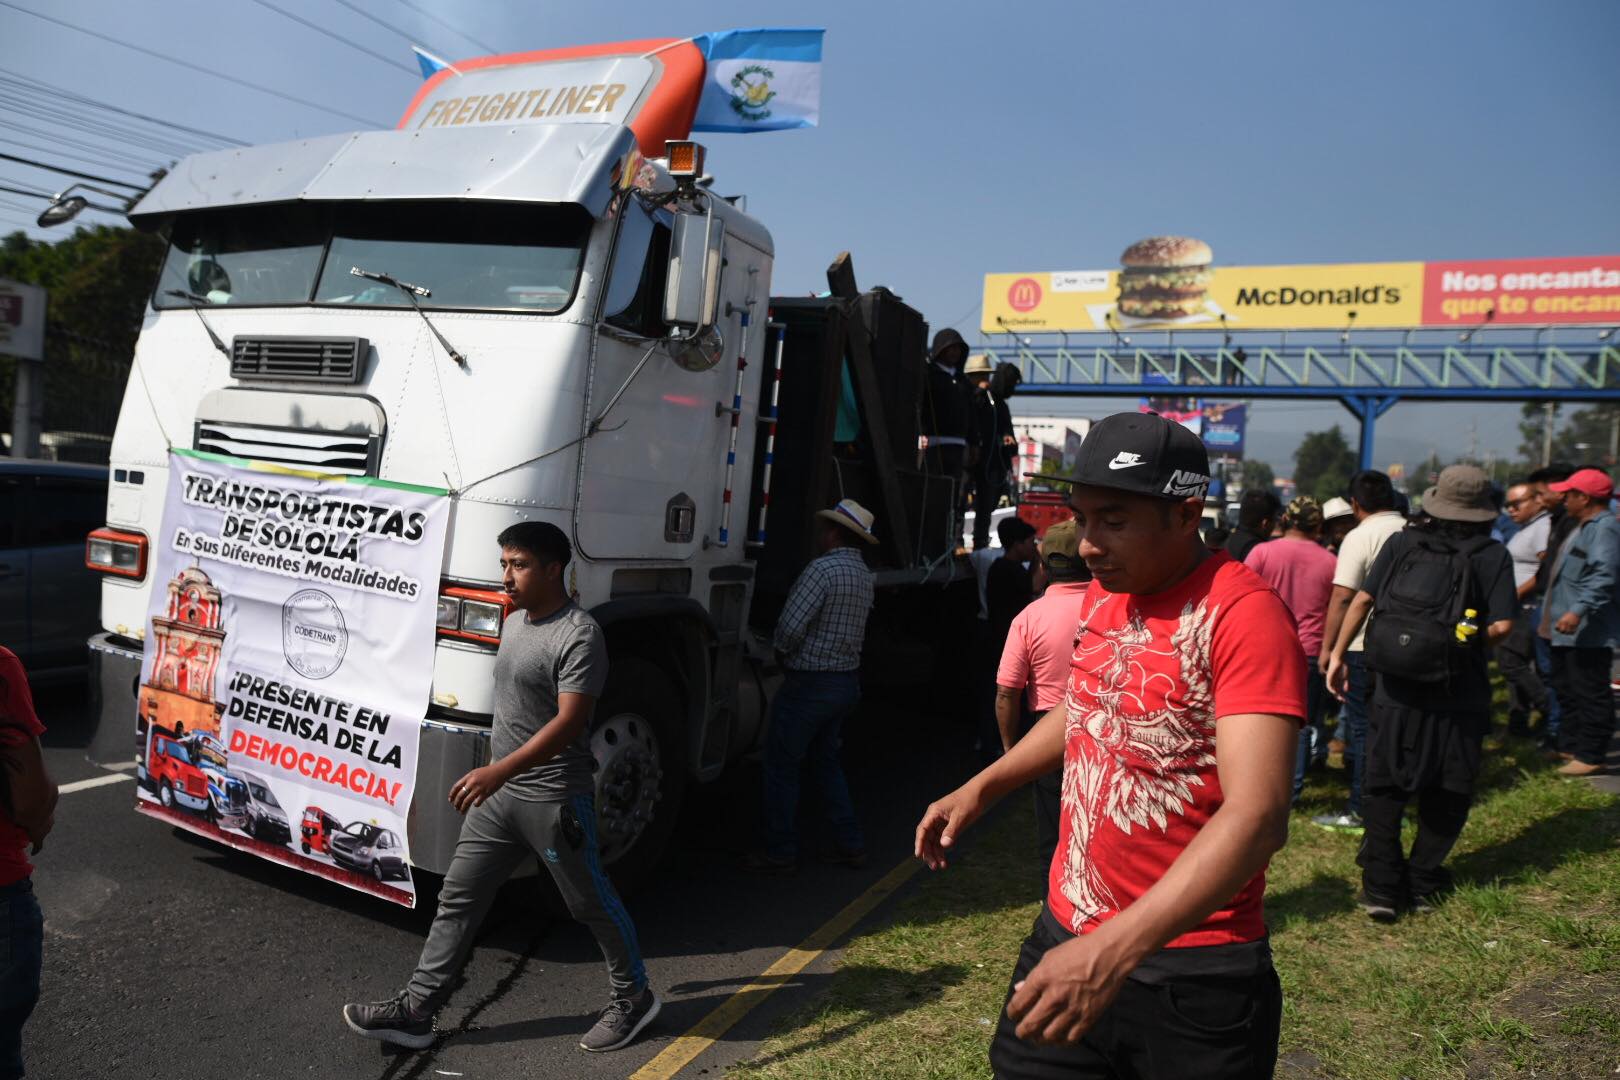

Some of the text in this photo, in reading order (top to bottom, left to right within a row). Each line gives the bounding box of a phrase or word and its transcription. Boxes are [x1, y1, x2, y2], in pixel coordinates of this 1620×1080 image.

[418, 84, 626, 129] FREIGHTLINER
[1236, 284, 1402, 306] McDonald's
[1442, 270, 1497, 292] Nos
[1442, 298, 1494, 320] que
[1499, 294, 1528, 314] te
[186, 475, 426, 540] TRANSPORTISTAS
[223, 515, 358, 562] DE SOLOLÁ
[176, 532, 417, 596] En Sus Diferentes Modalidades
[294, 625, 337, 643] CODETRANS
[229, 671, 391, 735] ¡PRESENTE EN
[228, 697, 401, 769] DEFENSA DE LA
[229, 729, 403, 806] DEMOCRACIA!
